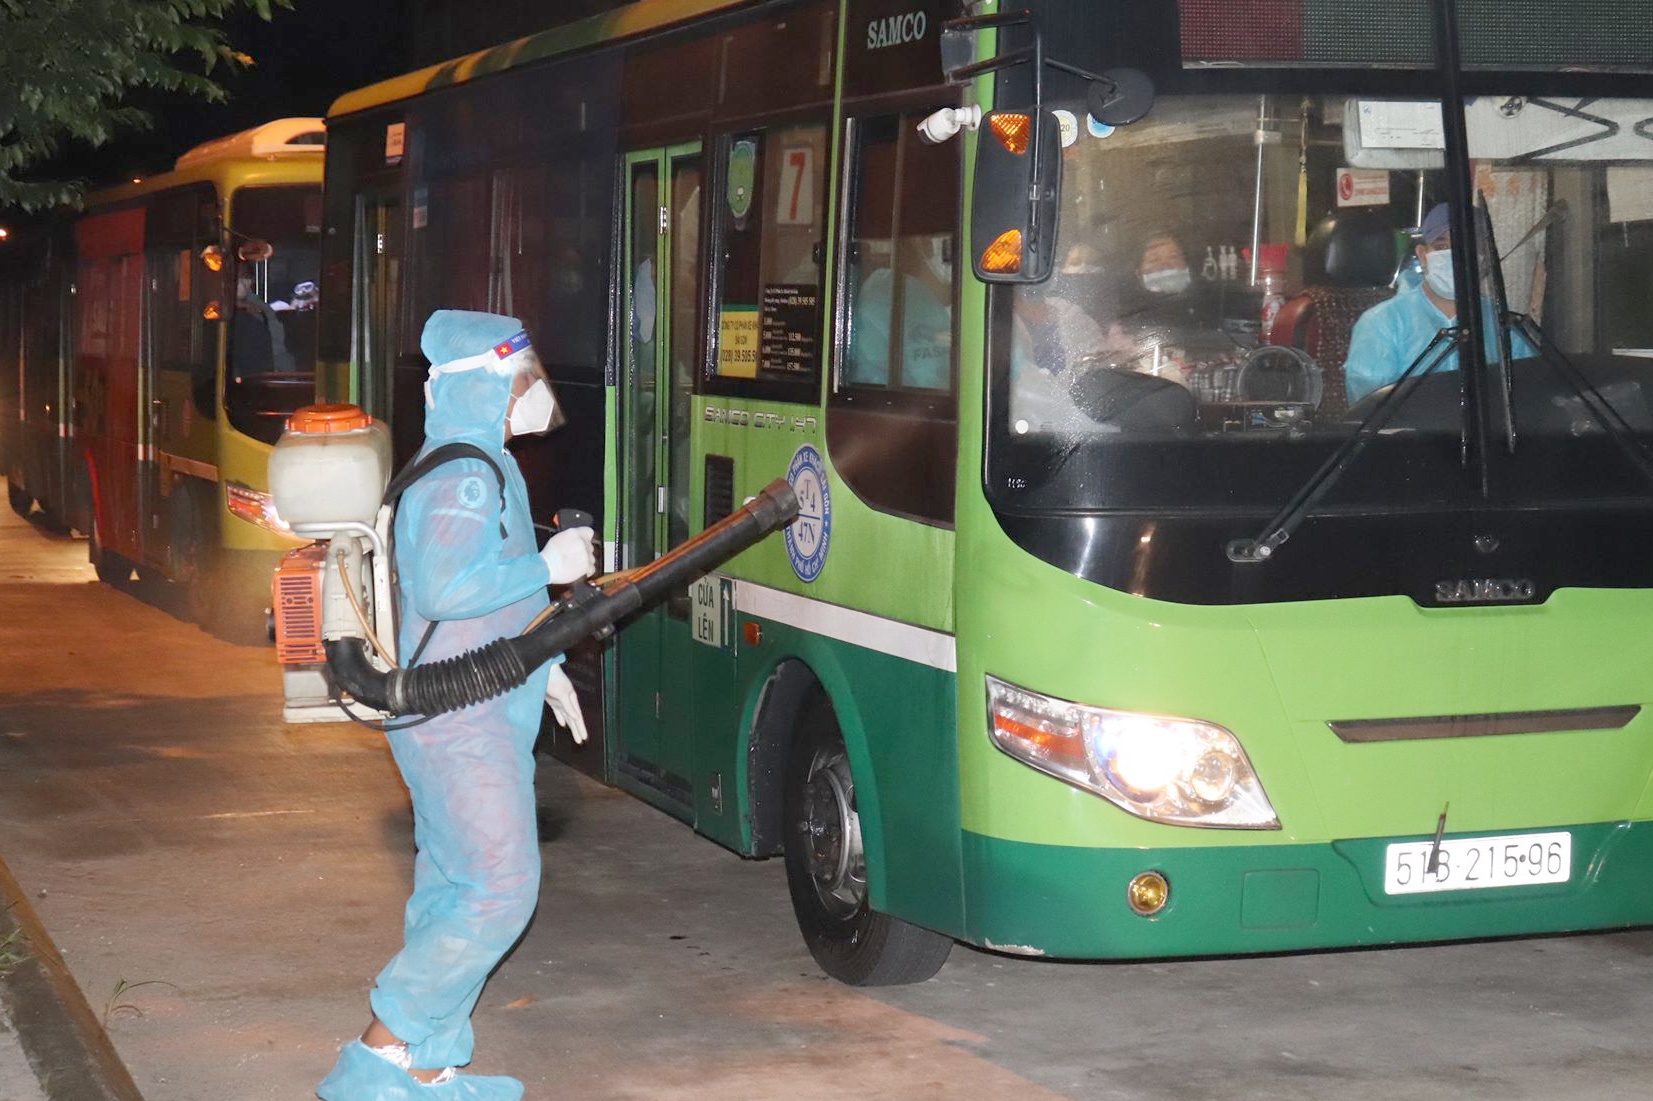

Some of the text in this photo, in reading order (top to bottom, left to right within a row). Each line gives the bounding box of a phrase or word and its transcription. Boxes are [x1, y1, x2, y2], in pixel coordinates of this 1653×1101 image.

[867, 10, 926, 49] SAMCO
[789, 151, 807, 221] 7
[704, 405, 749, 427] SAMCO
[754, 412, 785, 430] CITY
[698, 576, 714, 608] CỬA
[698, 612, 714, 642] LÊN
